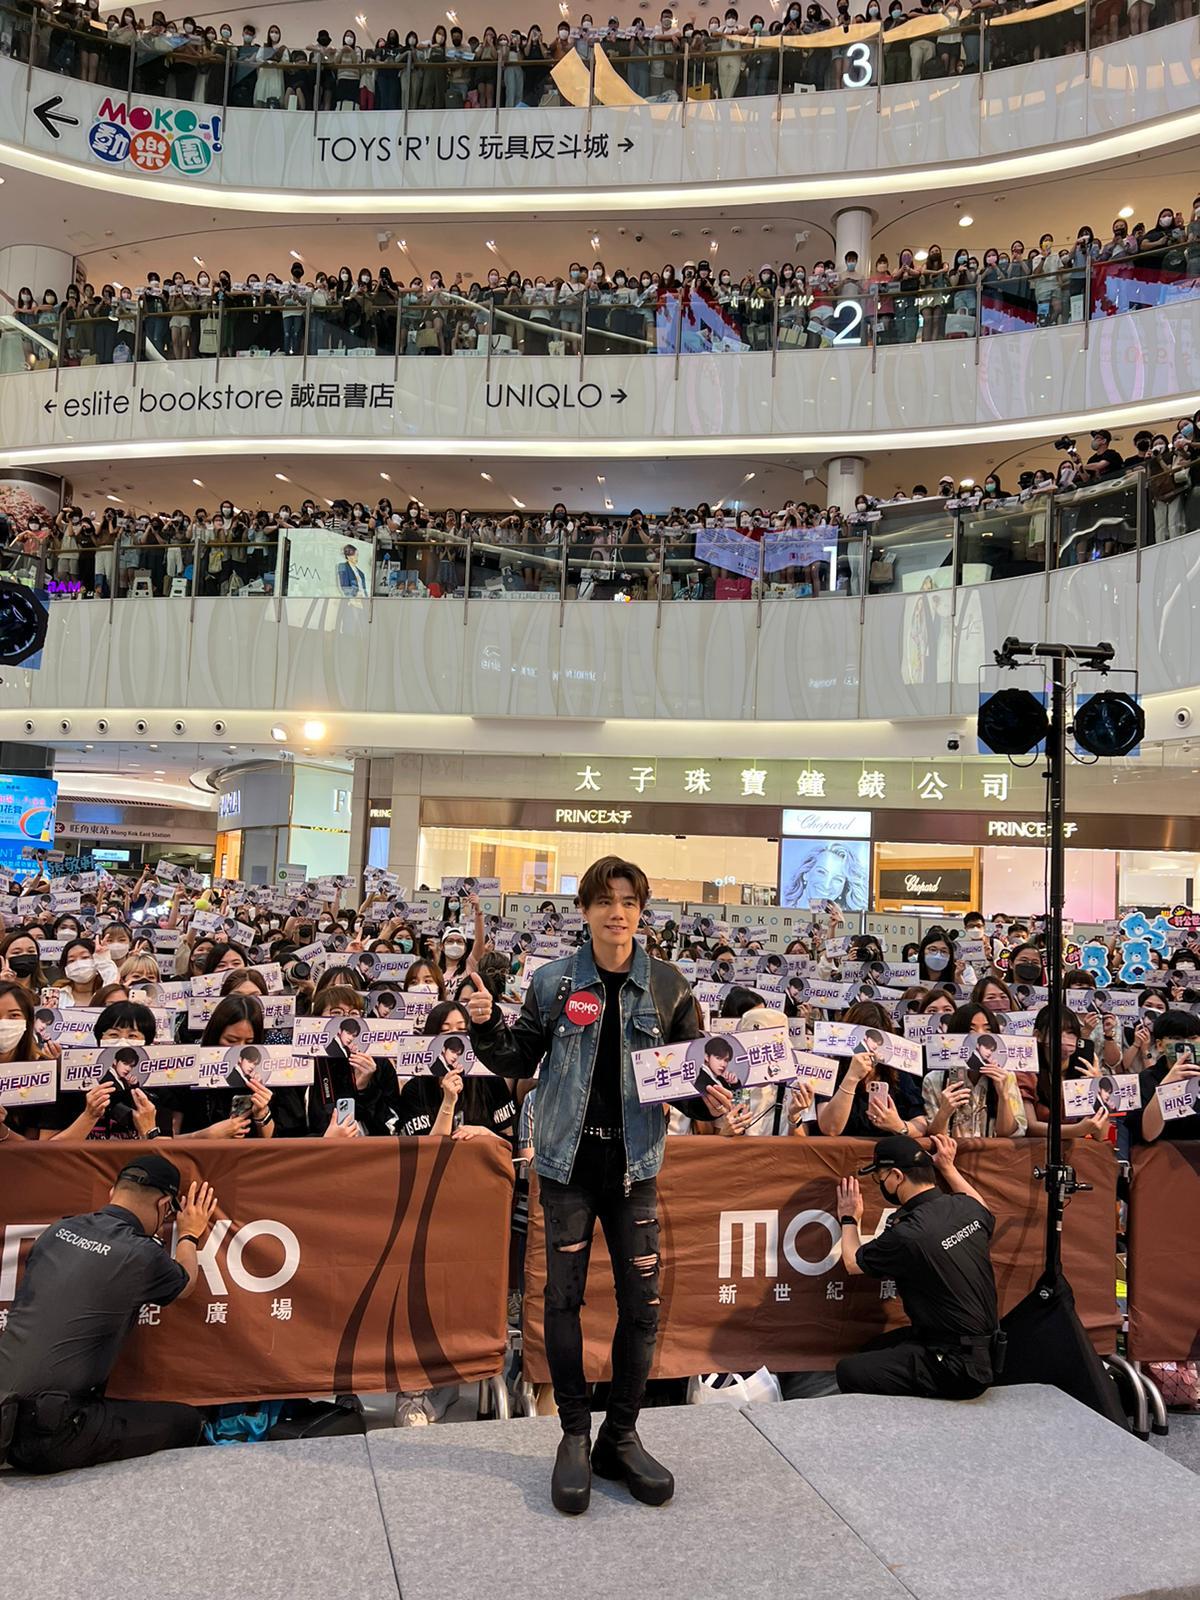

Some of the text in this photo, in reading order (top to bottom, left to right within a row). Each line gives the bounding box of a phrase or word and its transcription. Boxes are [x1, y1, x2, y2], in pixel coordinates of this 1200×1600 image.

[843, 43, 872, 88] 3
[317, 136, 391, 162] TOYS
[437, 135, 470, 161] US
[478, 133, 609, 160] 玩具反斗城
[833, 301, 863, 344] 2
[64, 383, 394, 417] eslite bookstore 誠品書店
[486, 383, 602, 409] UNIQLO
[823, 546, 837, 592] 1
[69, 824, 109, 835] 旺角東站
[798, 814, 856, 833] Chopard
[904, 874, 943, 896] Chopard
[374, 961, 410, 972] CHEUNG
[884, 969, 917, 978] CHEUNG
[158, 990, 194, 1001] CHEUN
[700, 993, 721, 1002] HINS
[804, 988, 839, 998] CHEUNG
[54, 1022, 95, 1033] CHEUN
[909, 1026, 933, 1036] HINS
[298, 1033, 328, 1045] HINS
[819, 1036, 857, 1047] 一生一起
[402, 1053, 432, 1065] HINS
[932, 1046, 969, 1060] 一生一起
[66, 1056, 195, 1080] HINS CHEUNG
[199, 1056, 309, 1077] HINS CHEUNG
[643, 1043, 787, 1088] 一生一起 一世未變
[1164, 1095, 1192, 1111] HINS
[412, 1114, 432, 1131] EASY
[55, 1228, 112, 1256] SECURSTAR
[941, 1220, 982, 1251] SECURSTAR
